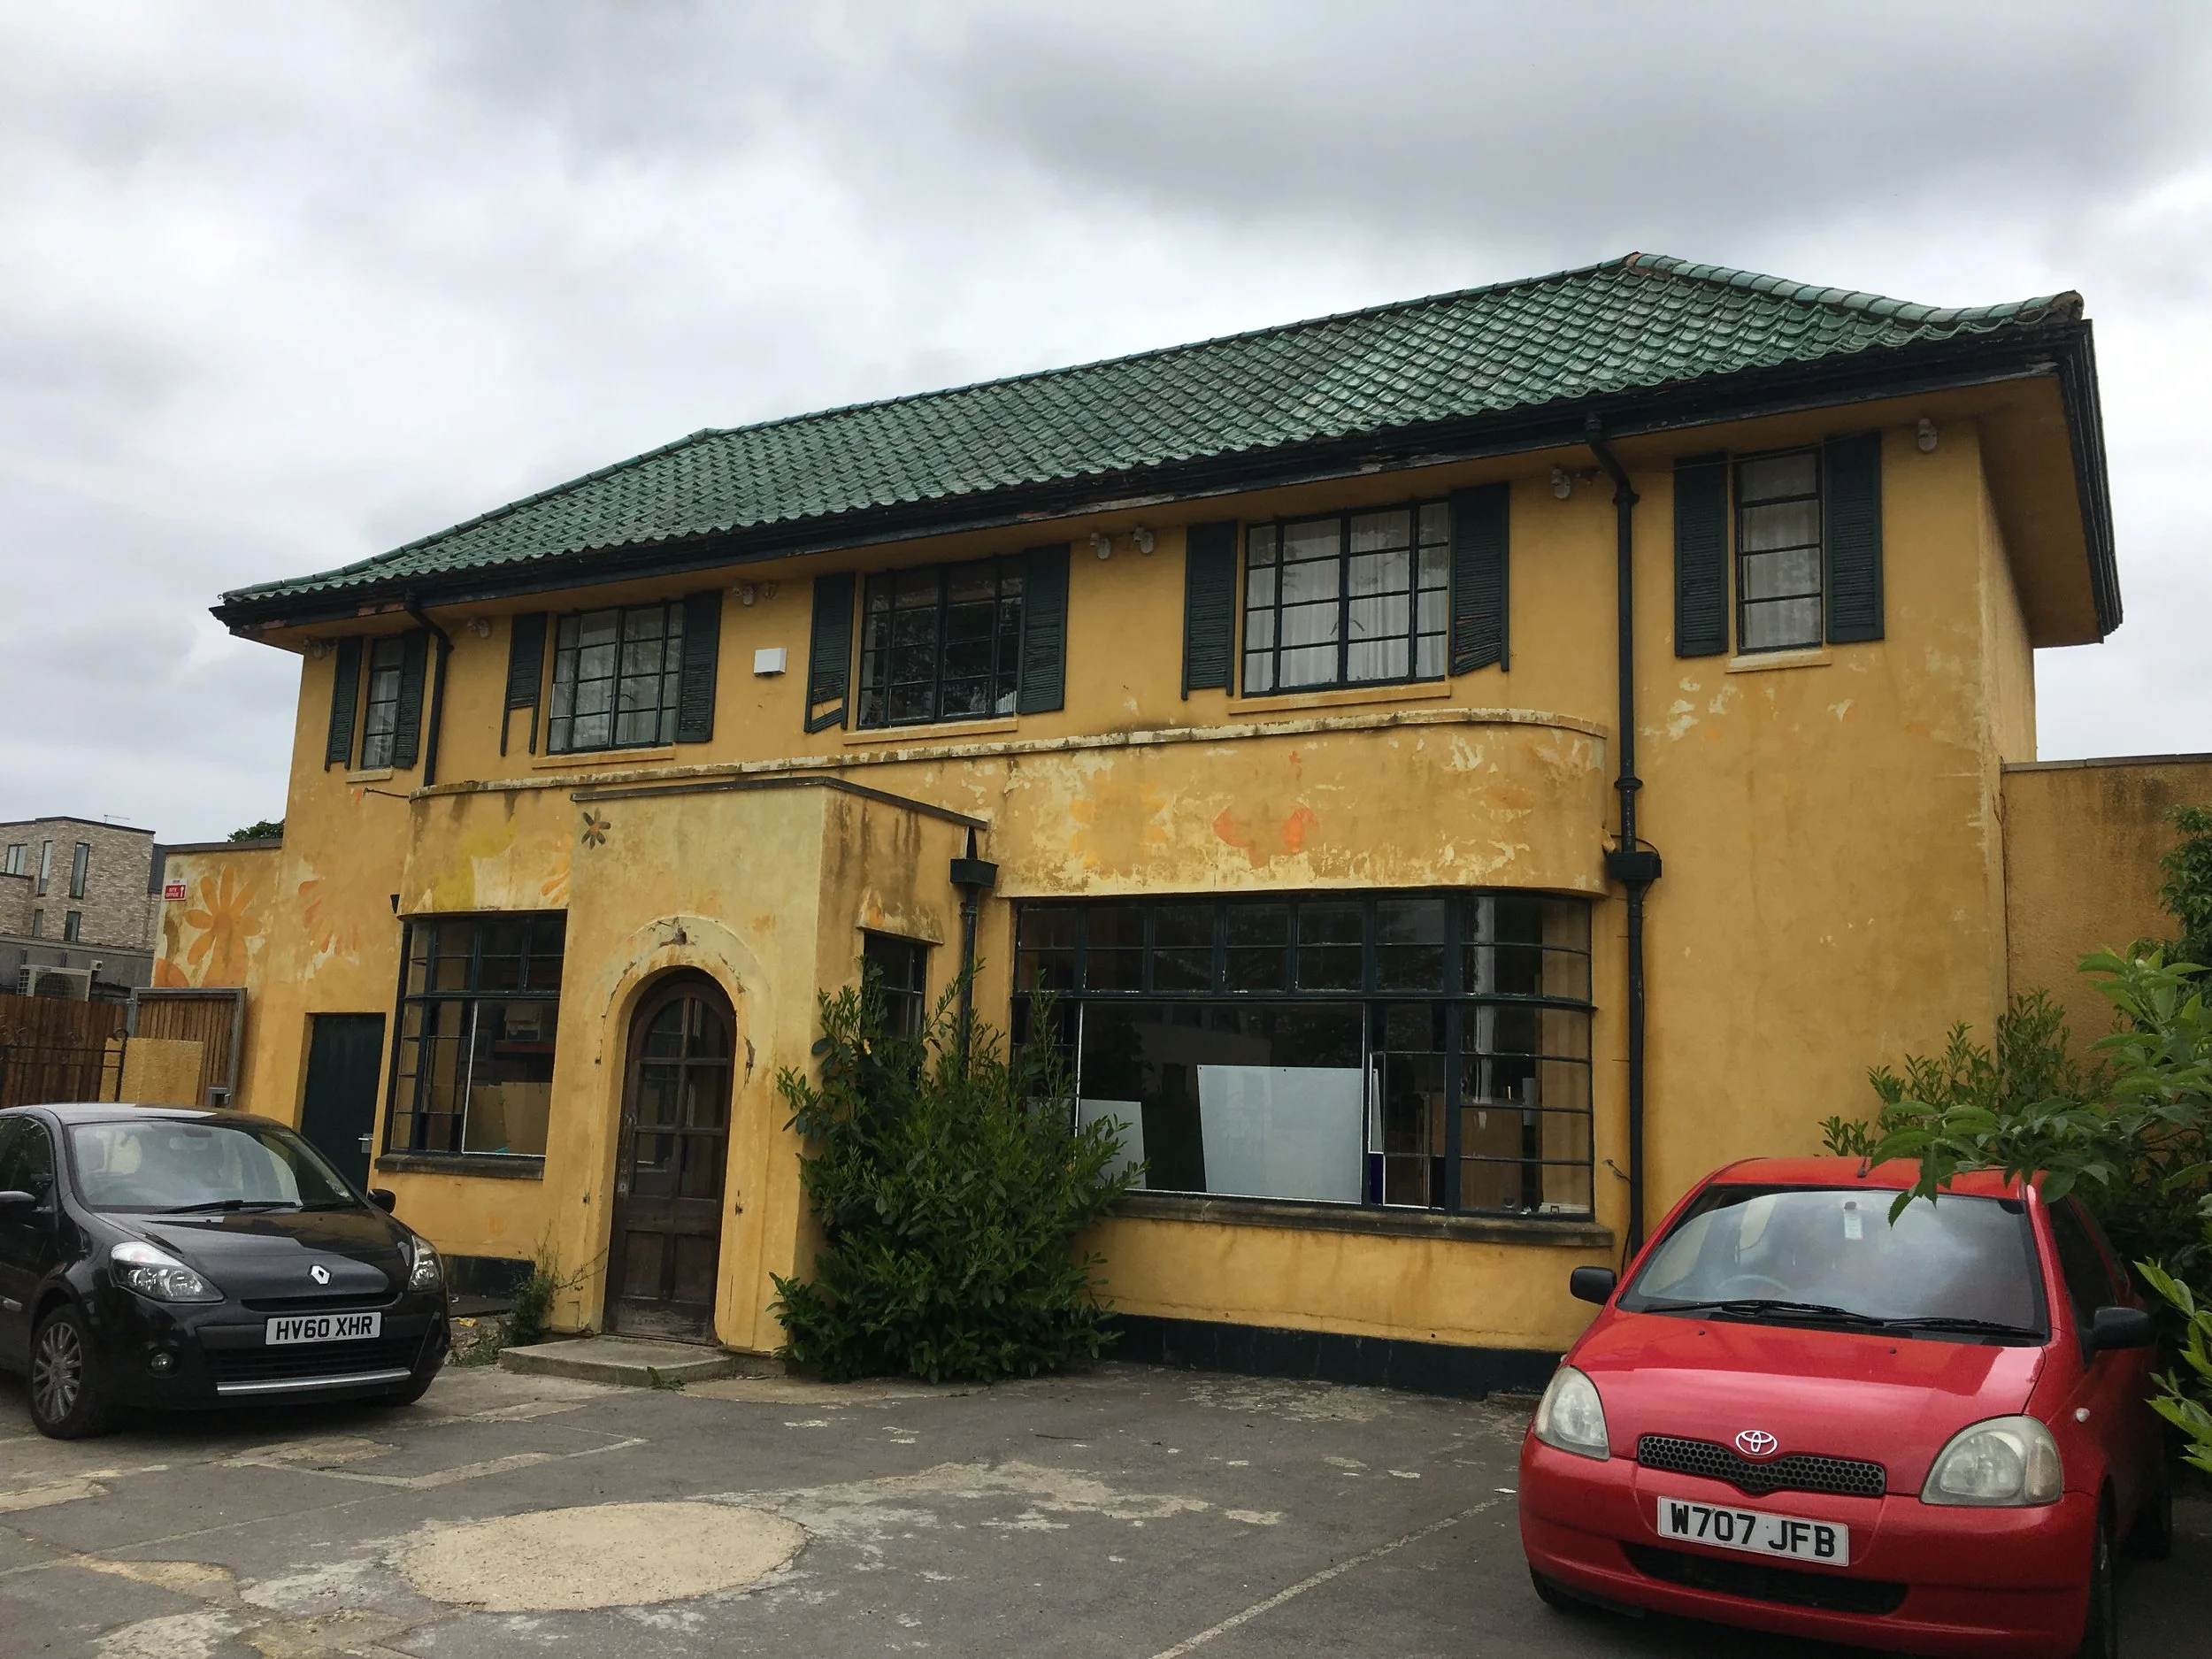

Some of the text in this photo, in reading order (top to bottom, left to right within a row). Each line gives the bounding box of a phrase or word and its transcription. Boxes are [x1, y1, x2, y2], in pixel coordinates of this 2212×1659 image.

[276, 1316, 373, 1340] HV60 XHR
[1671, 1502, 1836, 1558] W707 JFB
